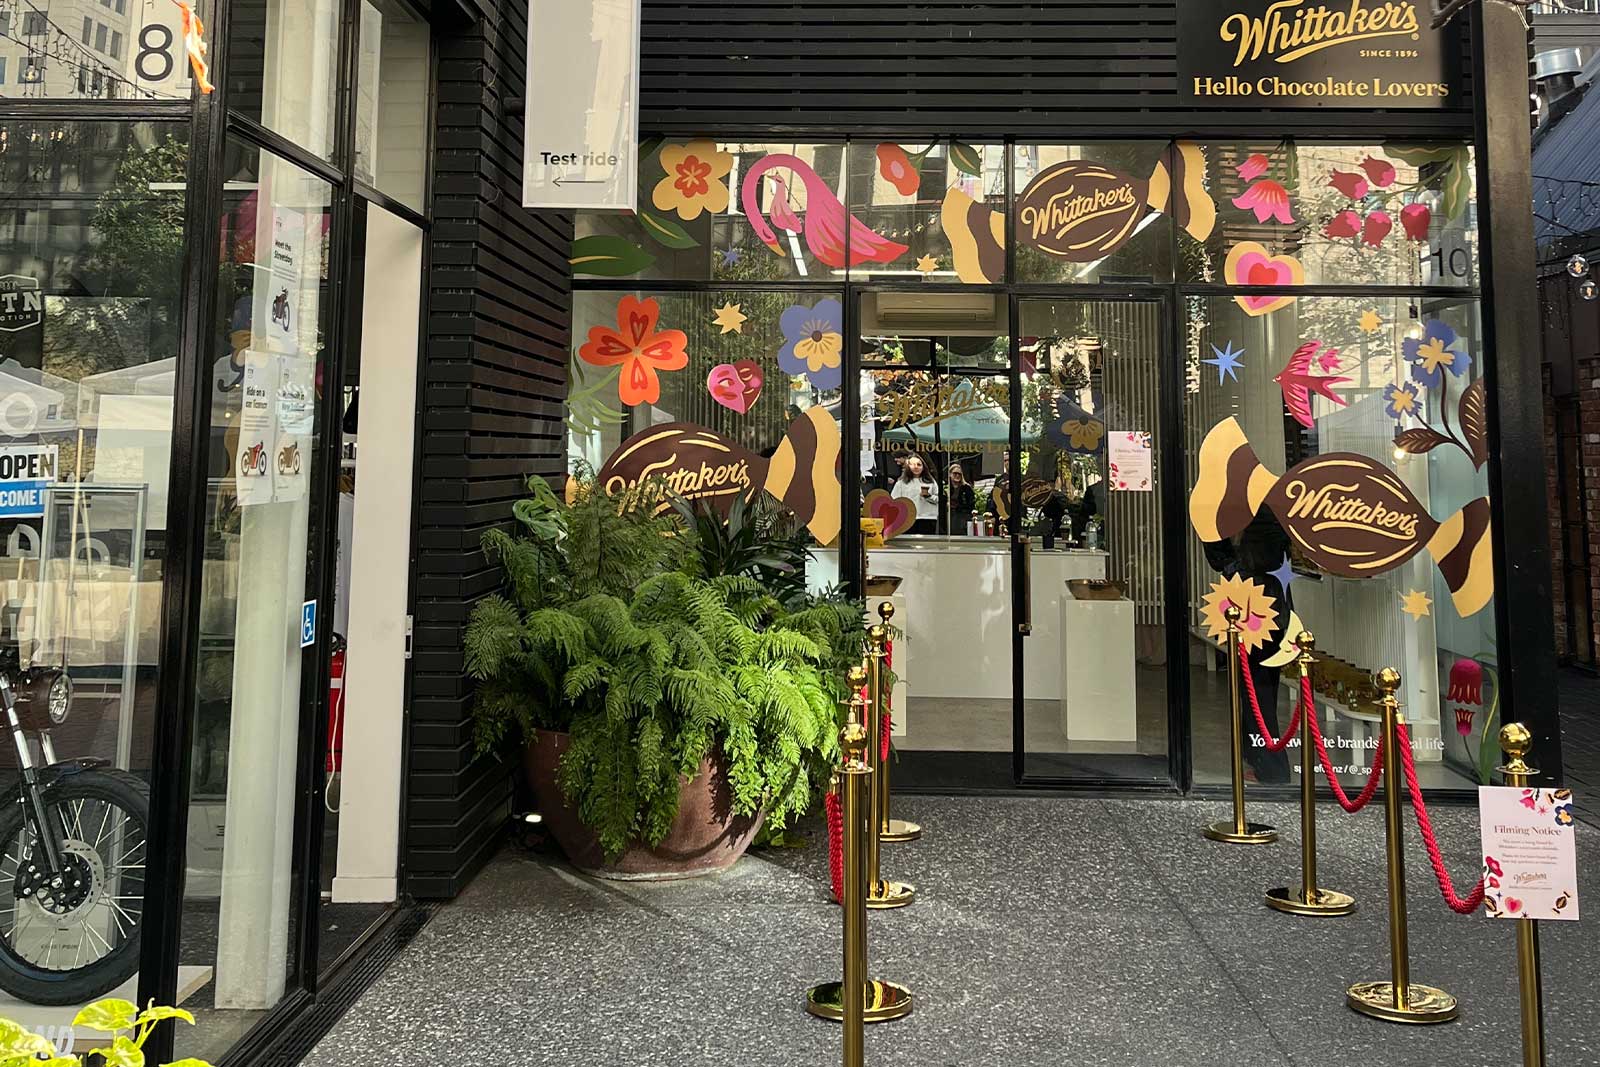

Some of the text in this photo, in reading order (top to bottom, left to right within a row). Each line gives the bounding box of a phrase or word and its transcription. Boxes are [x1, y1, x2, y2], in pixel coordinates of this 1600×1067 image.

[1220, 0, 1419, 67] Whittaker's
[135, 24, 173, 81] 8
[1395, 50, 1418, 58] 1896
[1193, 77, 1449, 97] Hello Chocolate Lovers
[540, 152, 618, 166] Test ride
[1020, 184, 1136, 239] Whittaker's
[1432, 247, 1468, 278] 10
[860, 438, 900, 452] Hello
[903, 438, 984, 453] Chocolate
[0, 453, 55, 480] OPEN
[1285, 479, 1419, 540] Whittaker's
[1337, 735, 1380, 750] brands
[1425, 736, 1445, 750] life
[1494, 824, 1561, 837] Filming Notice
